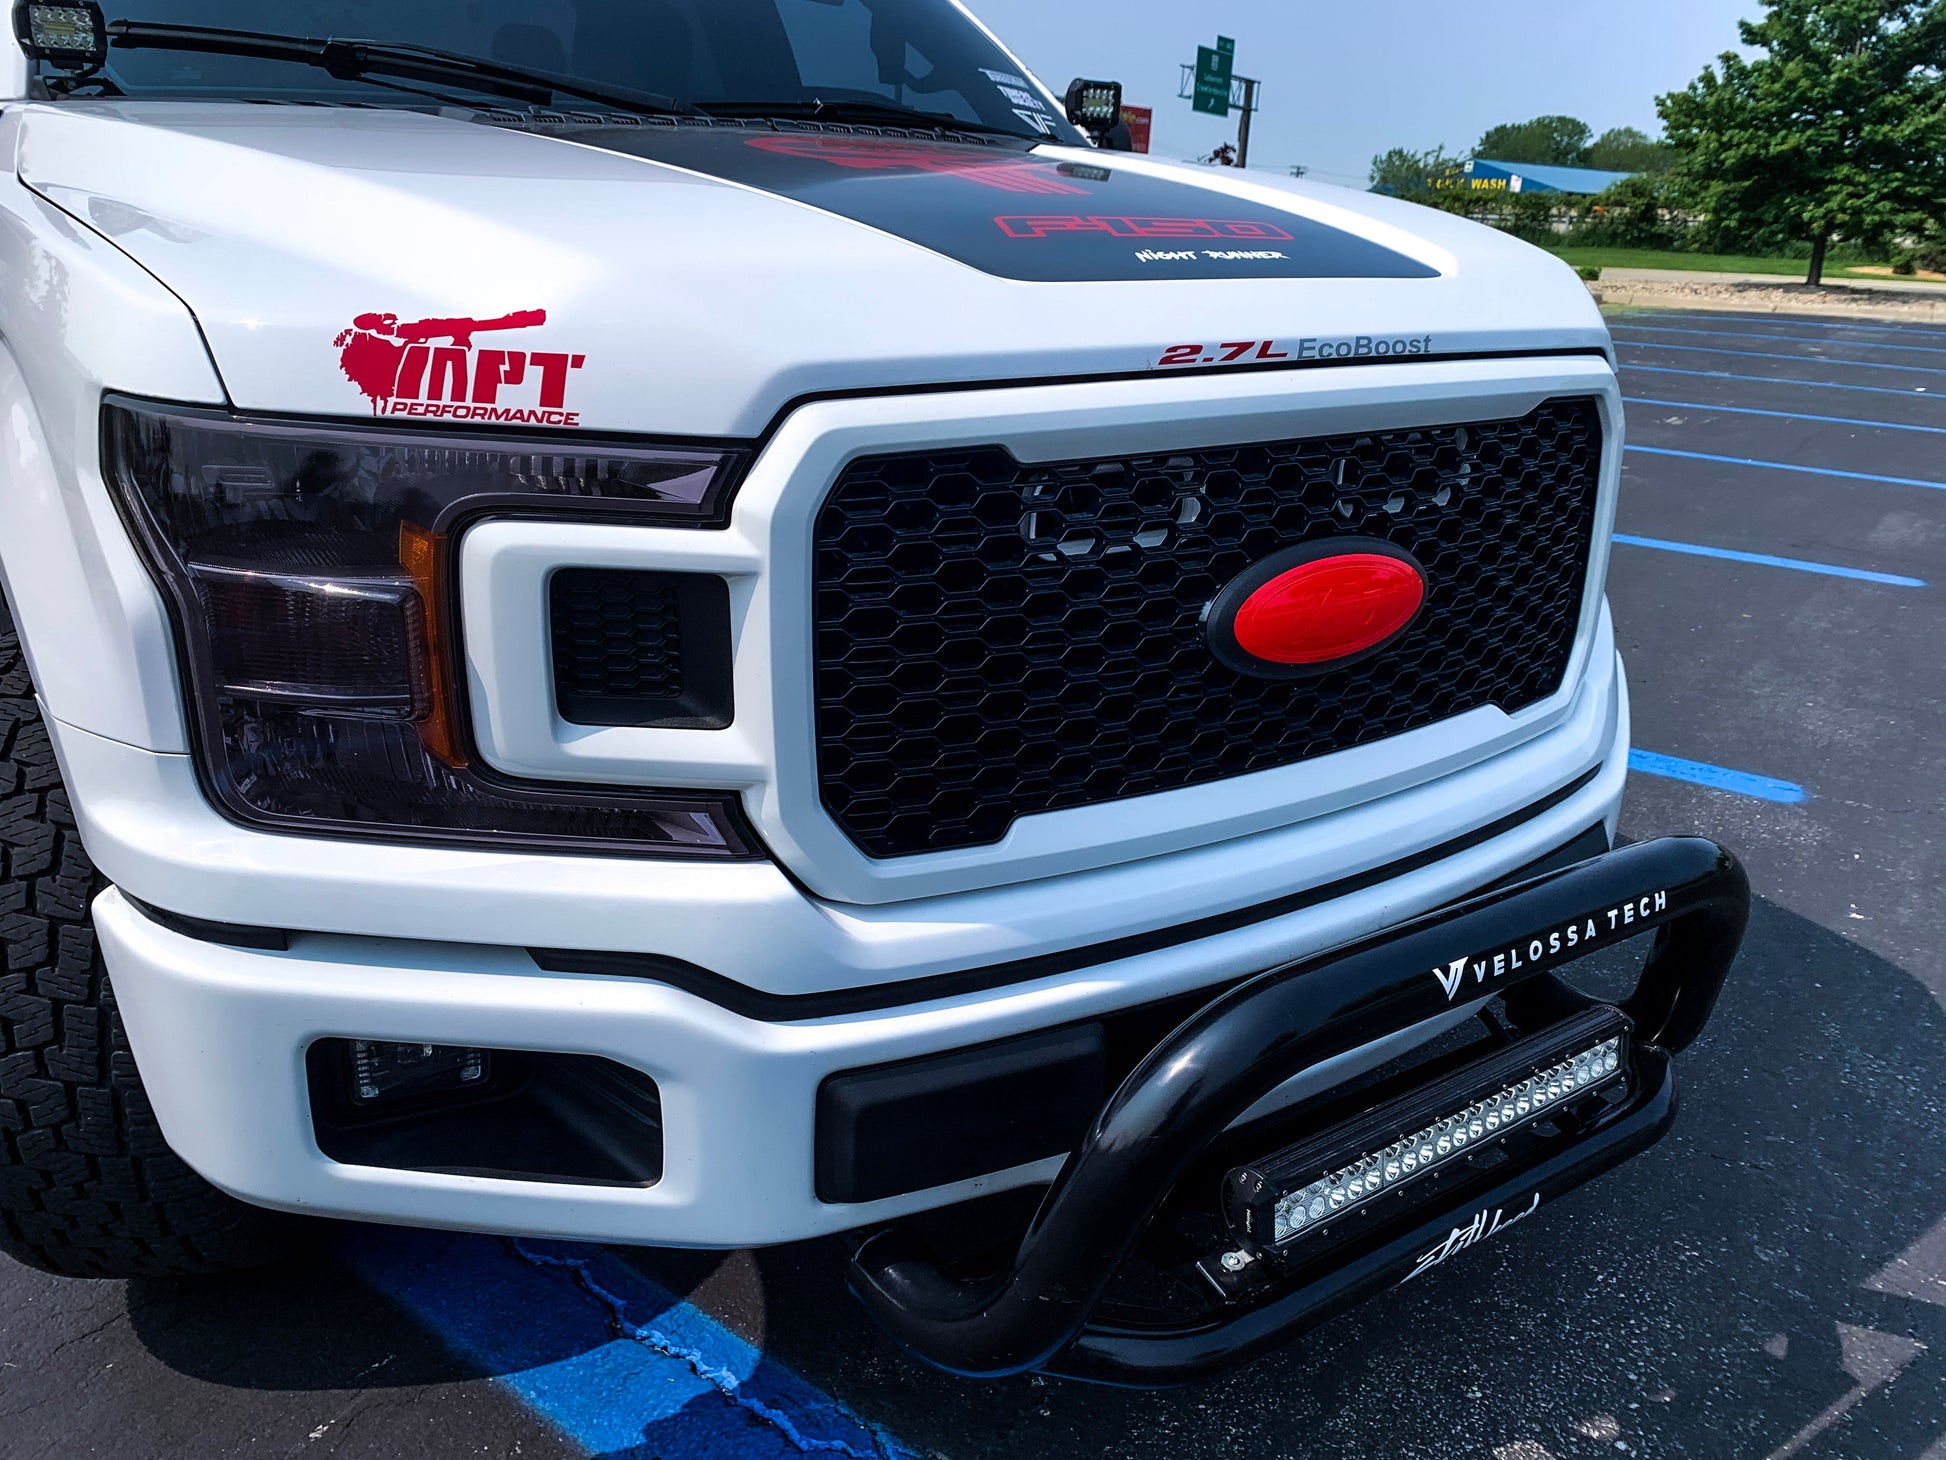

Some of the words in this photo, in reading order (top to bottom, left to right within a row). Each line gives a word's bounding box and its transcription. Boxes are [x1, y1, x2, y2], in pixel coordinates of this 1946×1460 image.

[1471, 178, 1507, 190] WASH
[1201, 249, 1291, 261] RUNNER
[1158, 340, 1288, 366] 2.7L
[1297, 334, 1432, 361] EcoBoost
[395, 345, 586, 409] MPT
[390, 402, 580, 427] PERFORMANCE
[1473, 918, 1597, 983] VELOSSA
[1607, 890, 1667, 930] TECH
